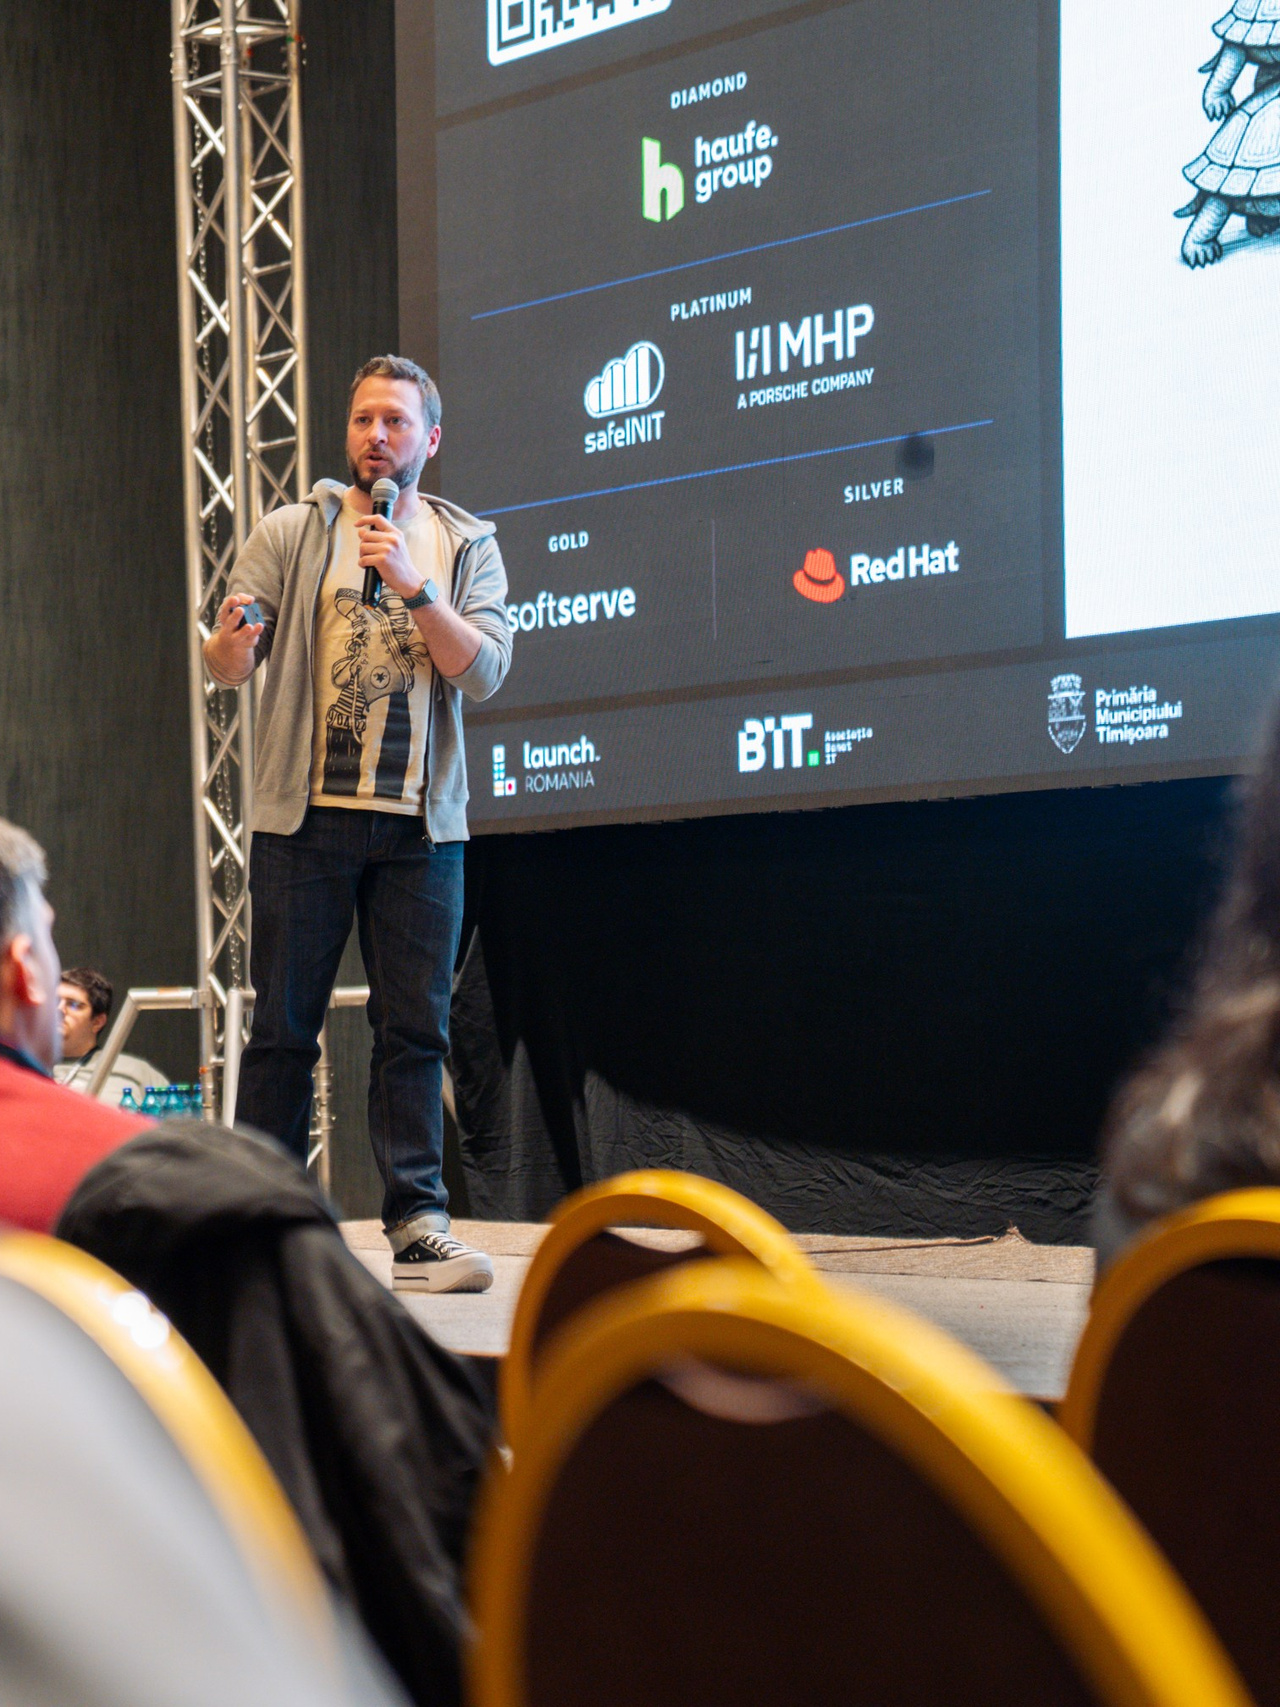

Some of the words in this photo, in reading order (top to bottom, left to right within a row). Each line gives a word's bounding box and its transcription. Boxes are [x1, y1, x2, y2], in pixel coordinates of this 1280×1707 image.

[671, 72, 747, 109] DIAMOND
[694, 119, 778, 168] haufe.
[694, 154, 773, 203] group
[671, 287, 751, 321] PLATINUM
[779, 303, 875, 372] MHP
[737, 393, 747, 409] A
[749, 378, 808, 407] PORSCHE
[810, 365, 874, 395] COMPANY
[585, 411, 665, 453] safeINIT
[844, 478, 903, 503] SILVER
[548, 531, 589, 552] GOLD
[850, 547, 905, 586] Red
[908, 540, 959, 578] Hat
[506, 586, 636, 634] softserve
[1095, 684, 1157, 708] Primăria
[1095, 700, 1182, 725] Municipiului
[523, 734, 601, 769] launch.
[1095, 723, 1168, 745] Timișoara
[525, 770, 595, 793] ROMANIA
